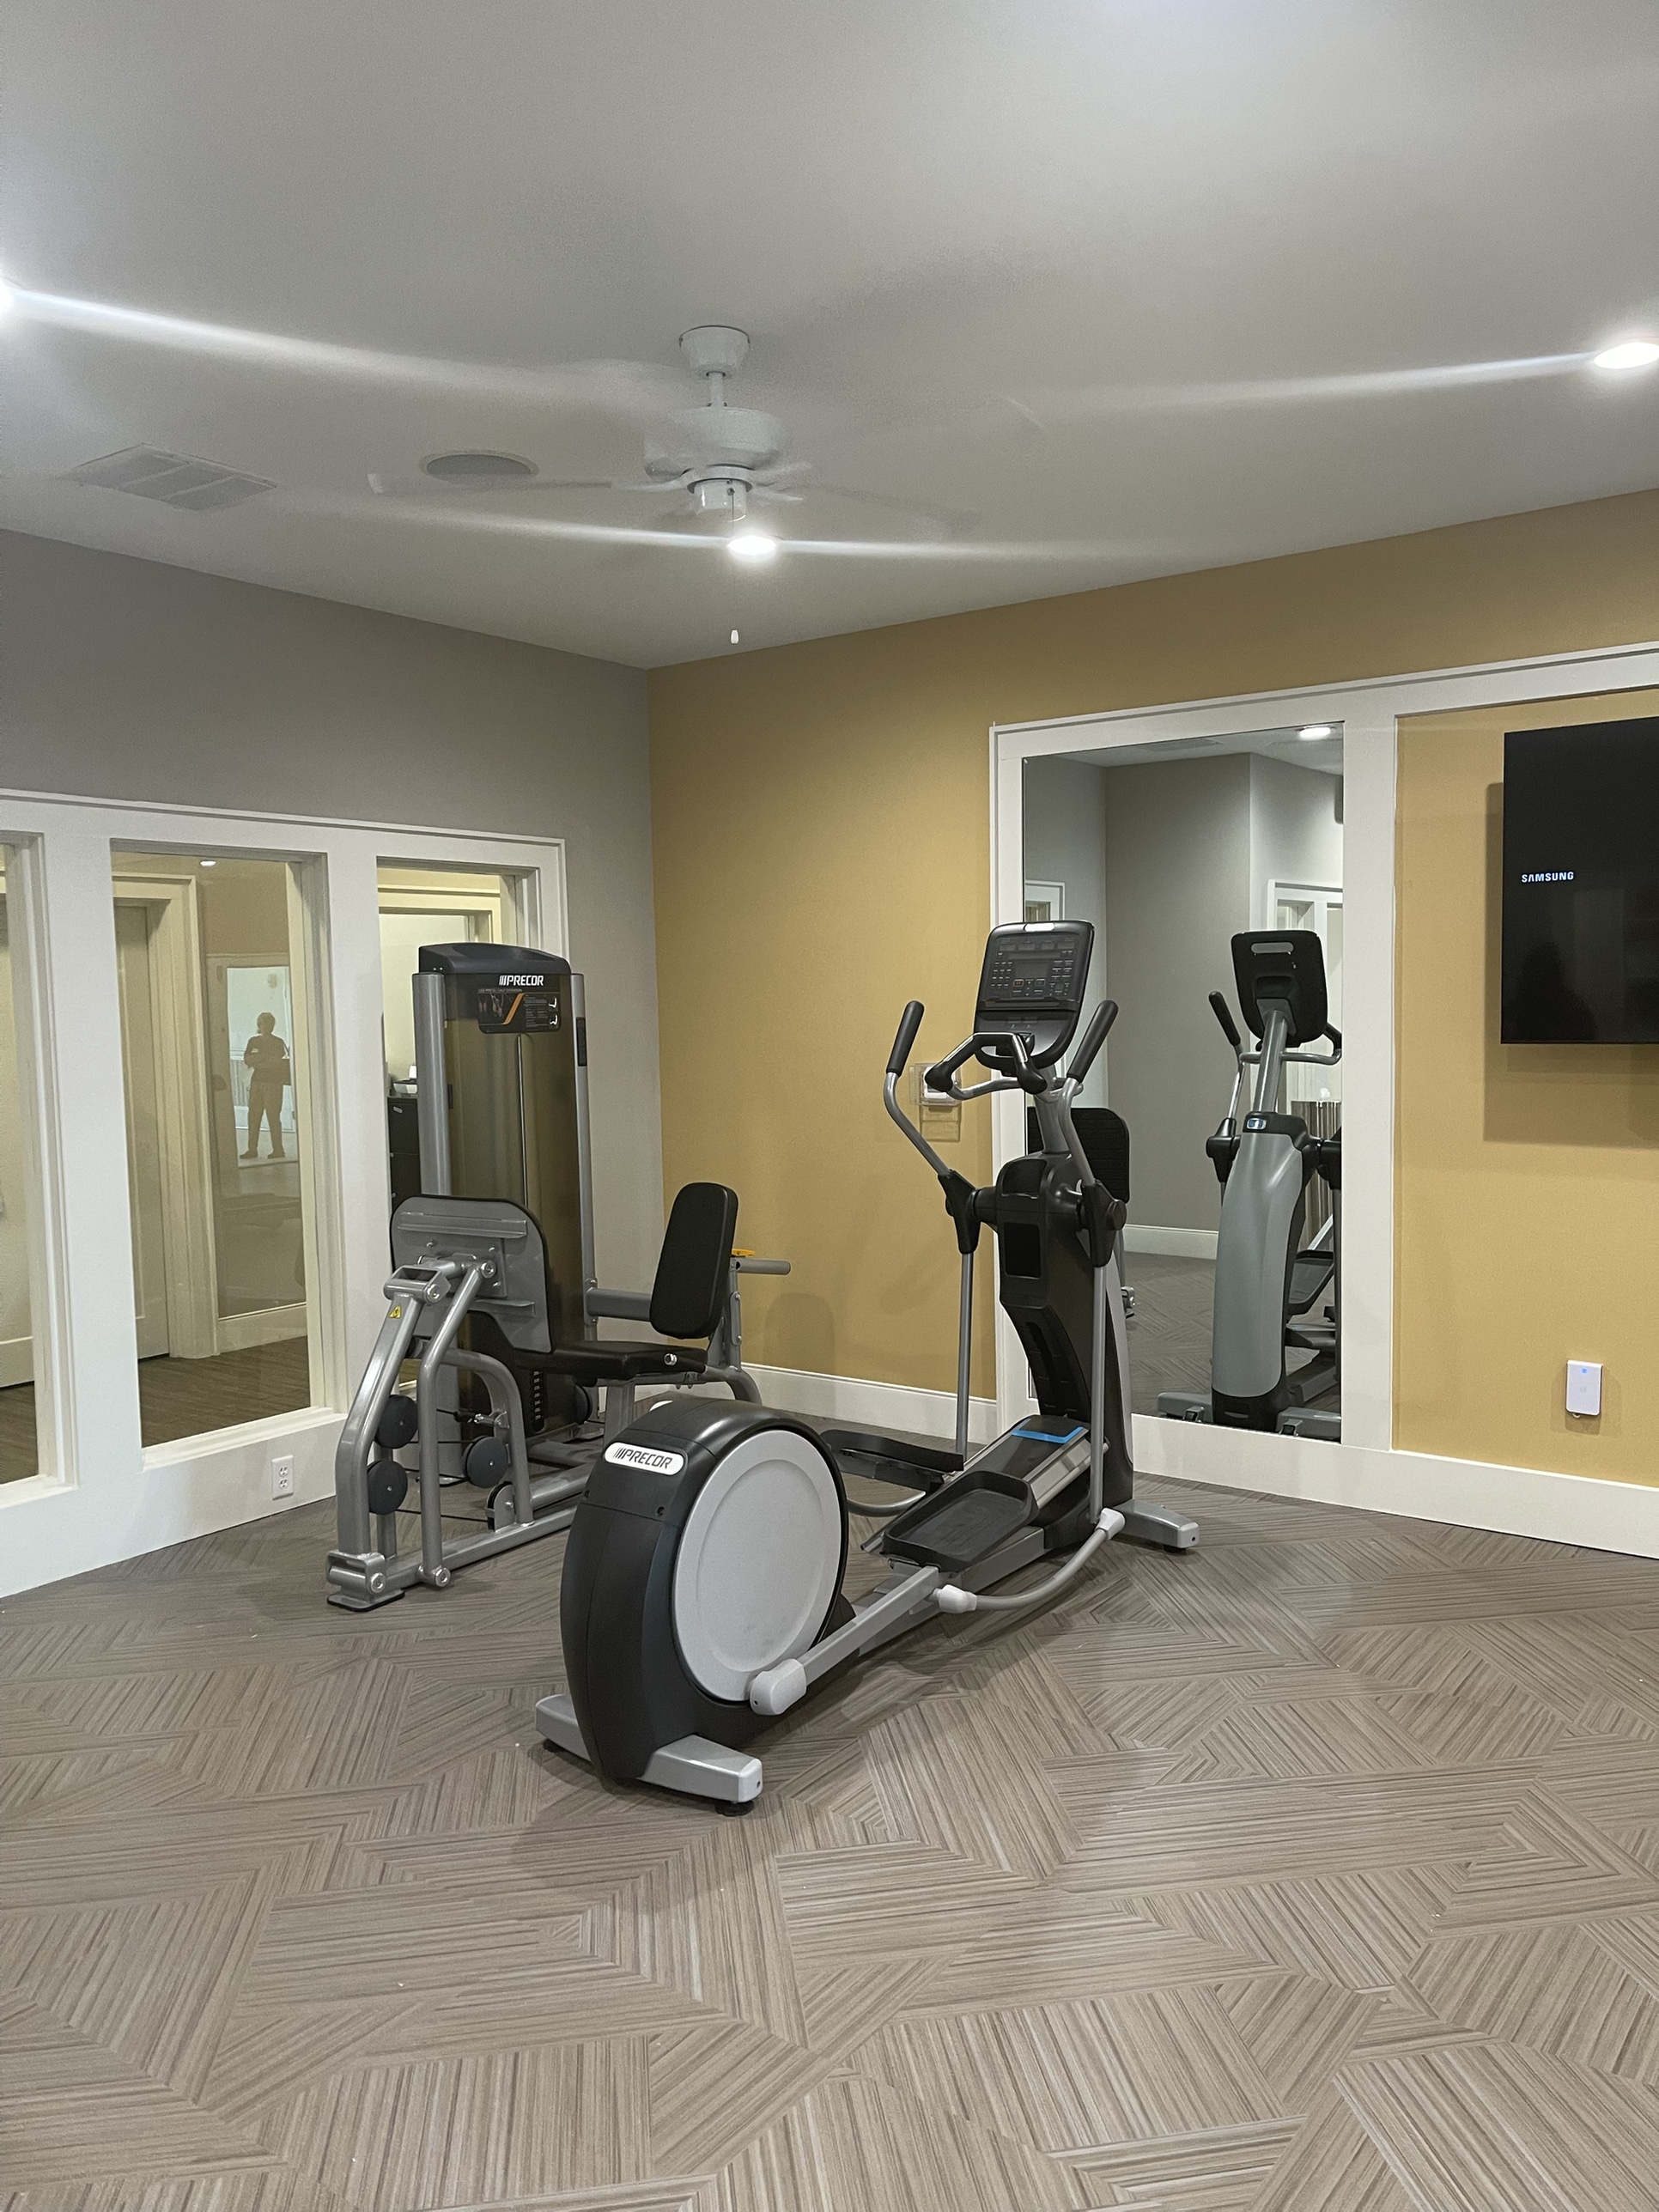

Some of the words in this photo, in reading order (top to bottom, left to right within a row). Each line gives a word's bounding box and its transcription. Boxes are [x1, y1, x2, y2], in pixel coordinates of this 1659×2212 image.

[1521, 871, 1574, 883] SAMSUNG
[505, 975, 544, 986] PRECOR
[620, 1449, 673, 1469] PRECOR
